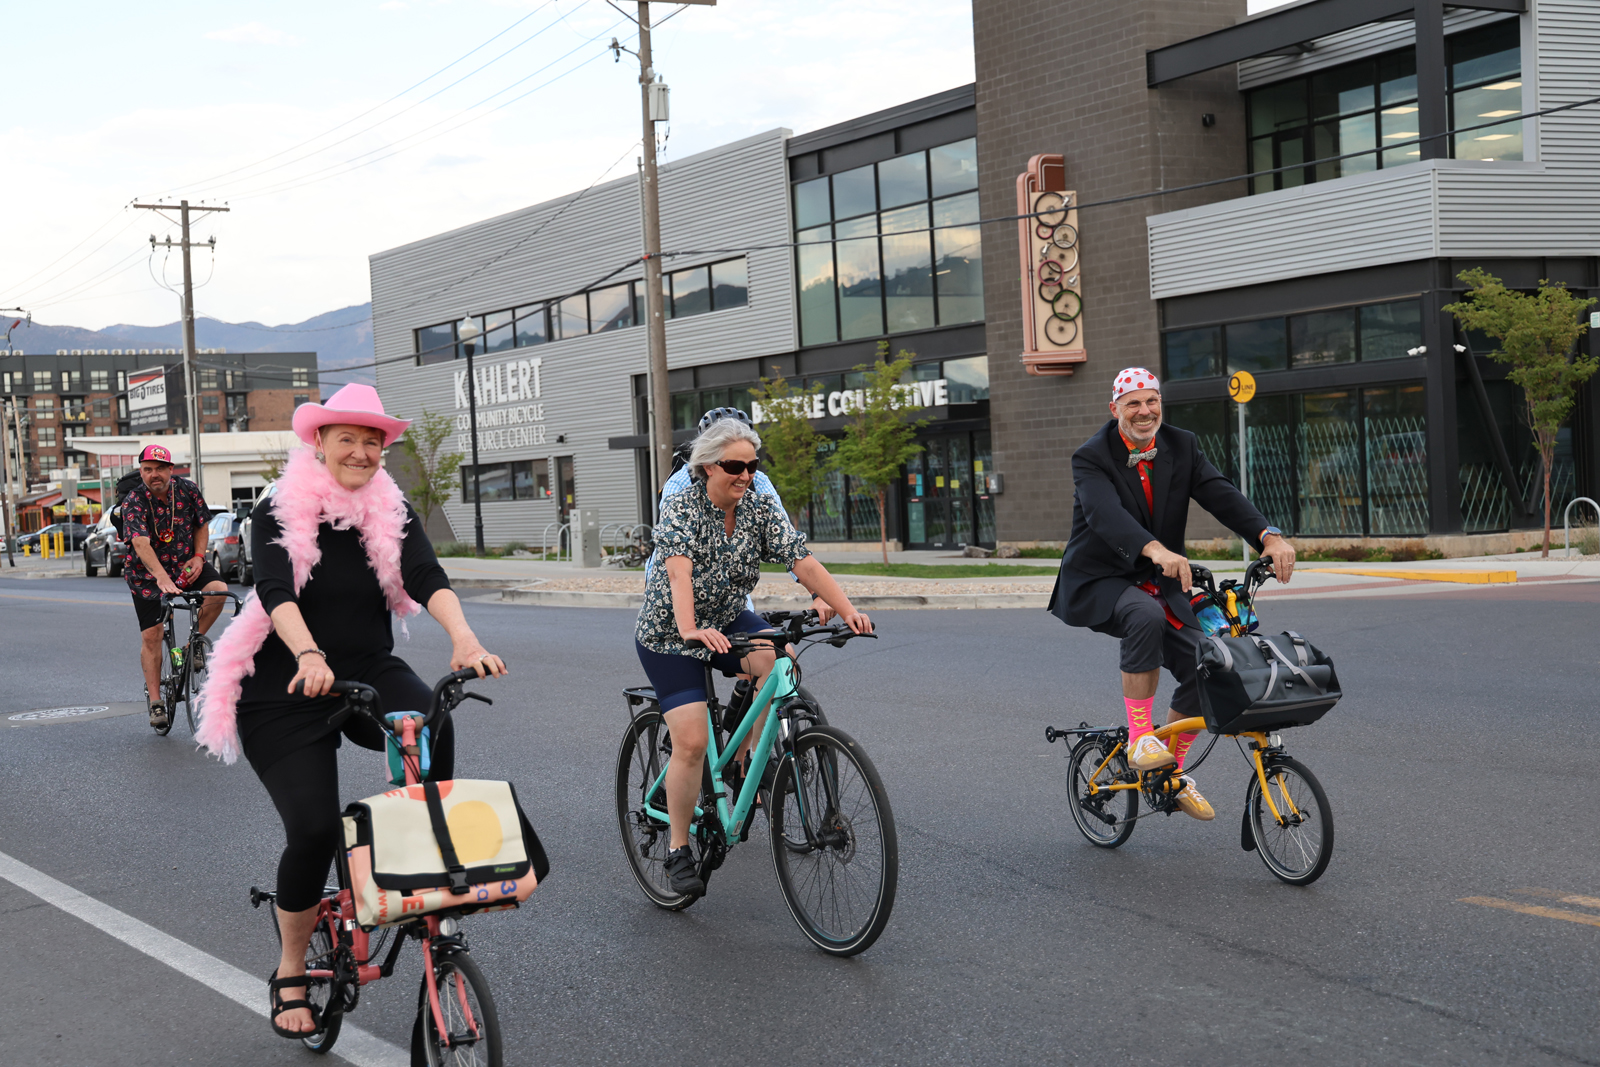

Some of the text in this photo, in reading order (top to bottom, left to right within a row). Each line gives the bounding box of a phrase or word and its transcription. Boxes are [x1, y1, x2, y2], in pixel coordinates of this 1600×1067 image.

[130, 388, 140, 399] BIG
[146, 384, 164, 396] TIRES
[454, 358, 542, 409] KAHLERT
[1229, 376, 1241, 398] 9
[456, 404, 545, 430] COMUNITY BICYCLE
[507, 424, 546, 448] CENTER
